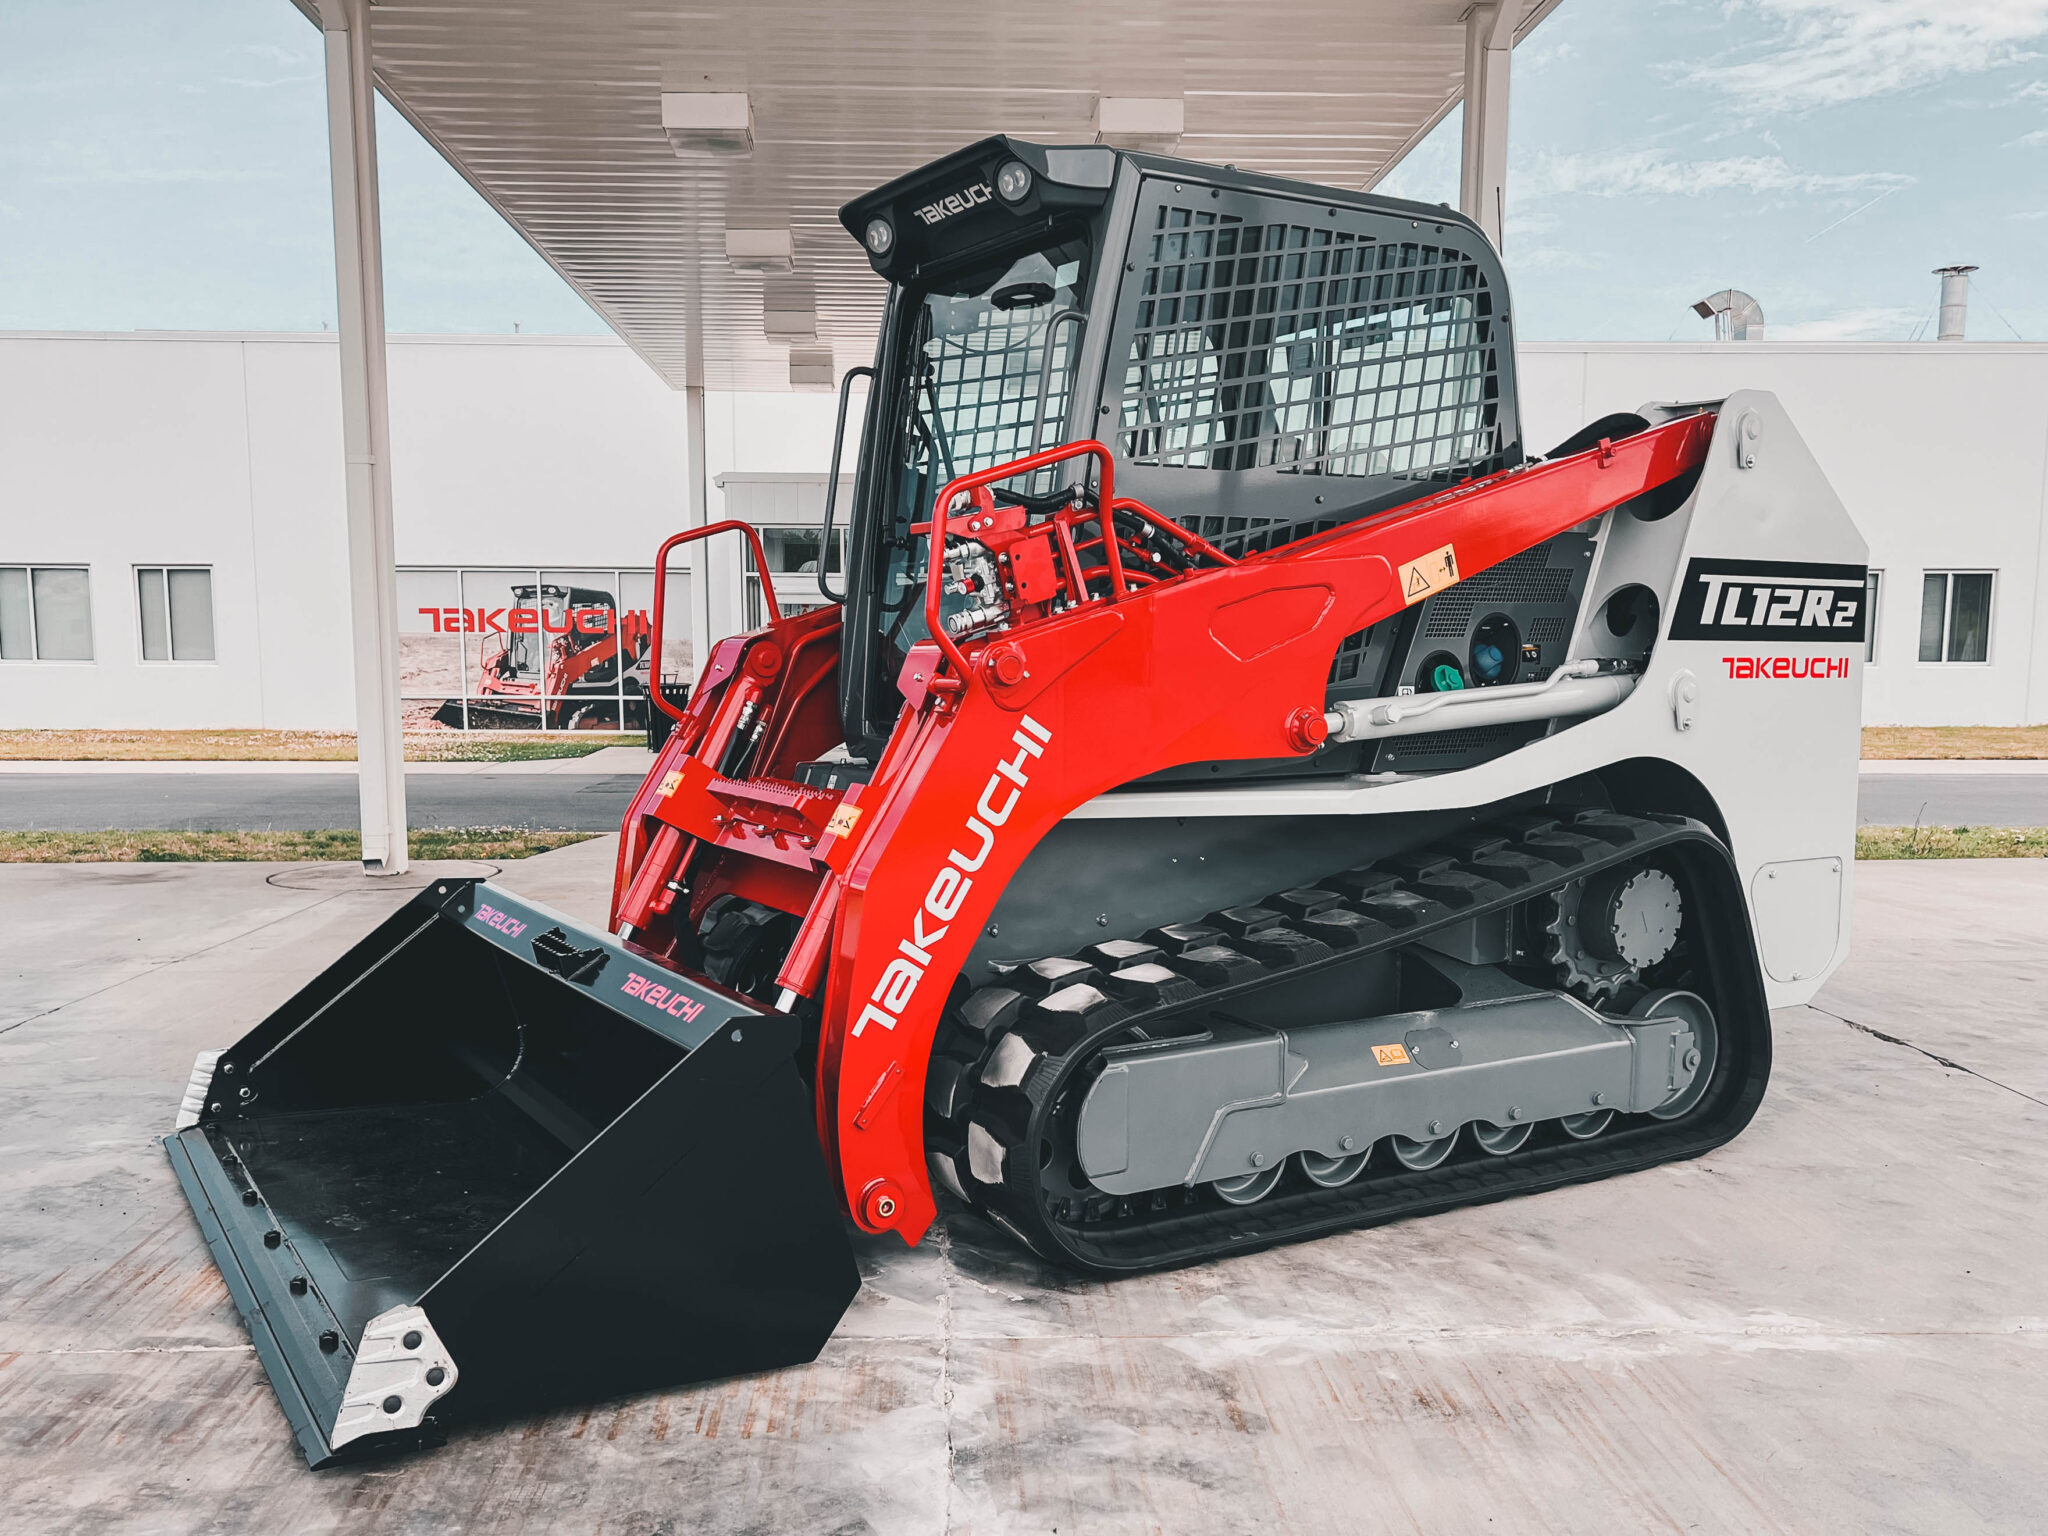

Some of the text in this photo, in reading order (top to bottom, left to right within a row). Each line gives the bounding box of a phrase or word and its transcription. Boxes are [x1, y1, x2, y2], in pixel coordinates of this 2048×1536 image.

[913, 183, 993, 225] TAKEUCH
[418, 607, 647, 634] TAKEUCHI
[1722, 657, 1849, 679] TAKEUCHI
[851, 714, 1053, 1038] TAKEUCHI
[474, 903, 528, 938] TAKEUCHI
[620, 972, 705, 1024] TAKEUCHI
